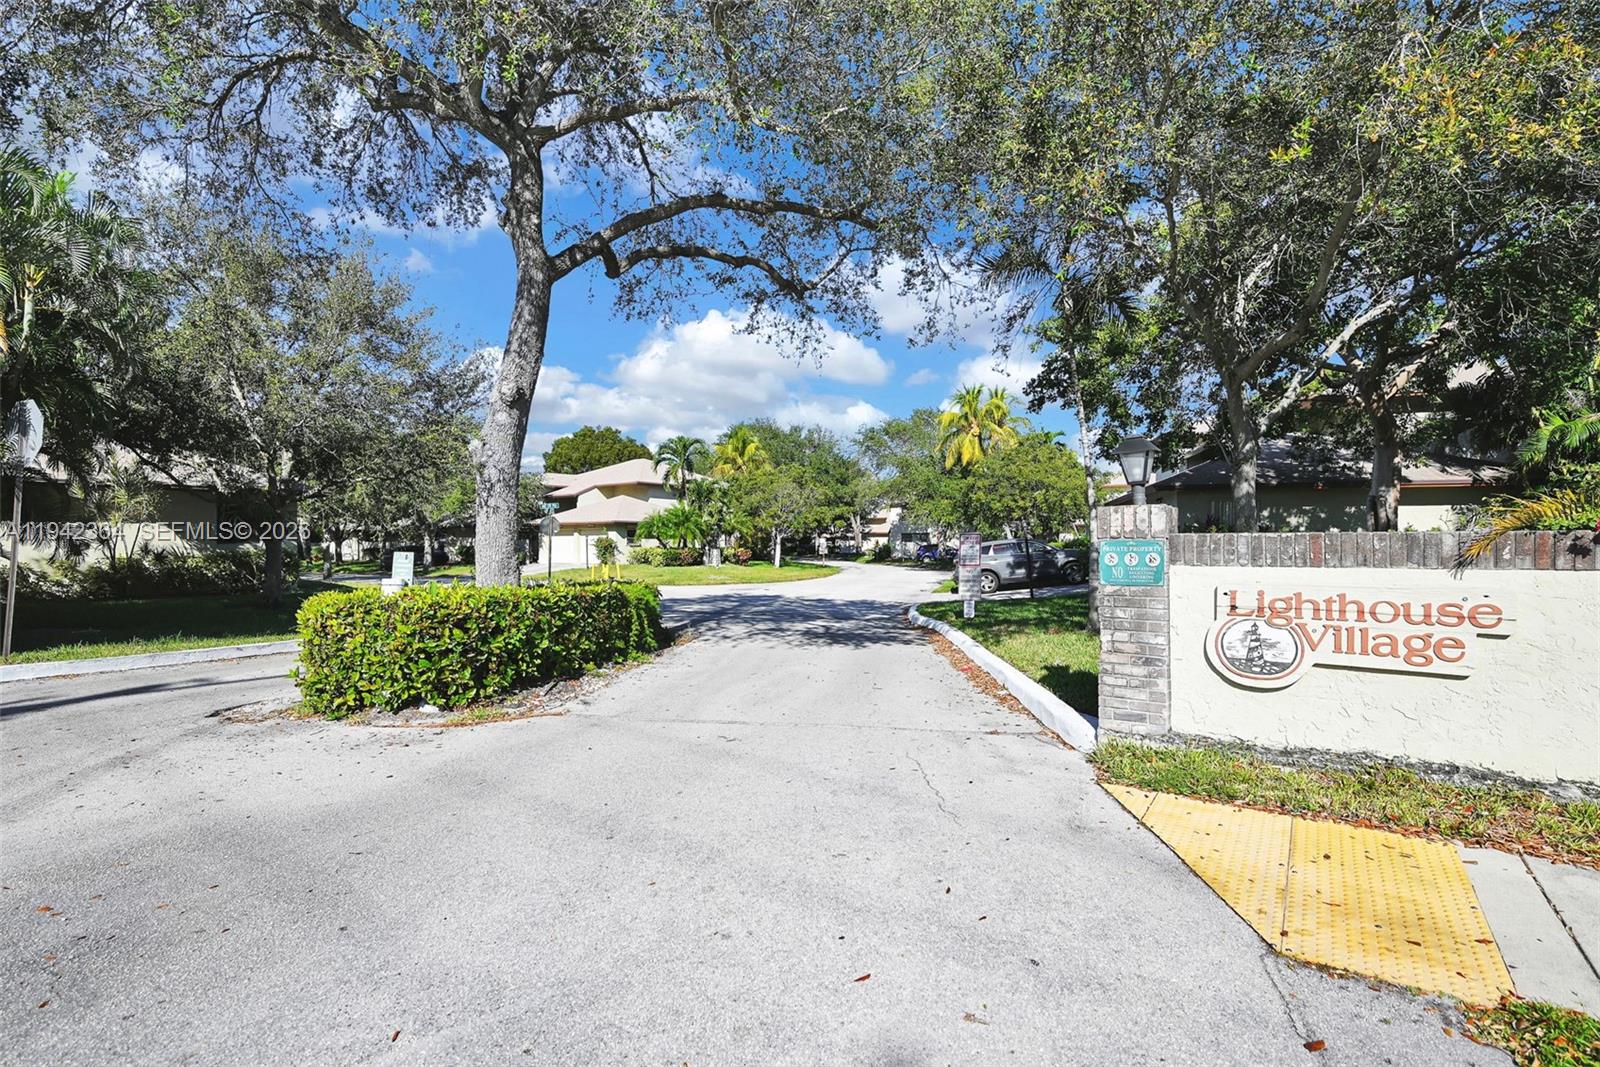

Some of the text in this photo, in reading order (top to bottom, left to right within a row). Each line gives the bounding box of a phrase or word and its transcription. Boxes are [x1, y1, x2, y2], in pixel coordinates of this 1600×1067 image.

[1112, 567, 1123, 579] NO
[1226, 589, 1503, 629] Lighthouse
[1295, 623, 1466, 667] Village
